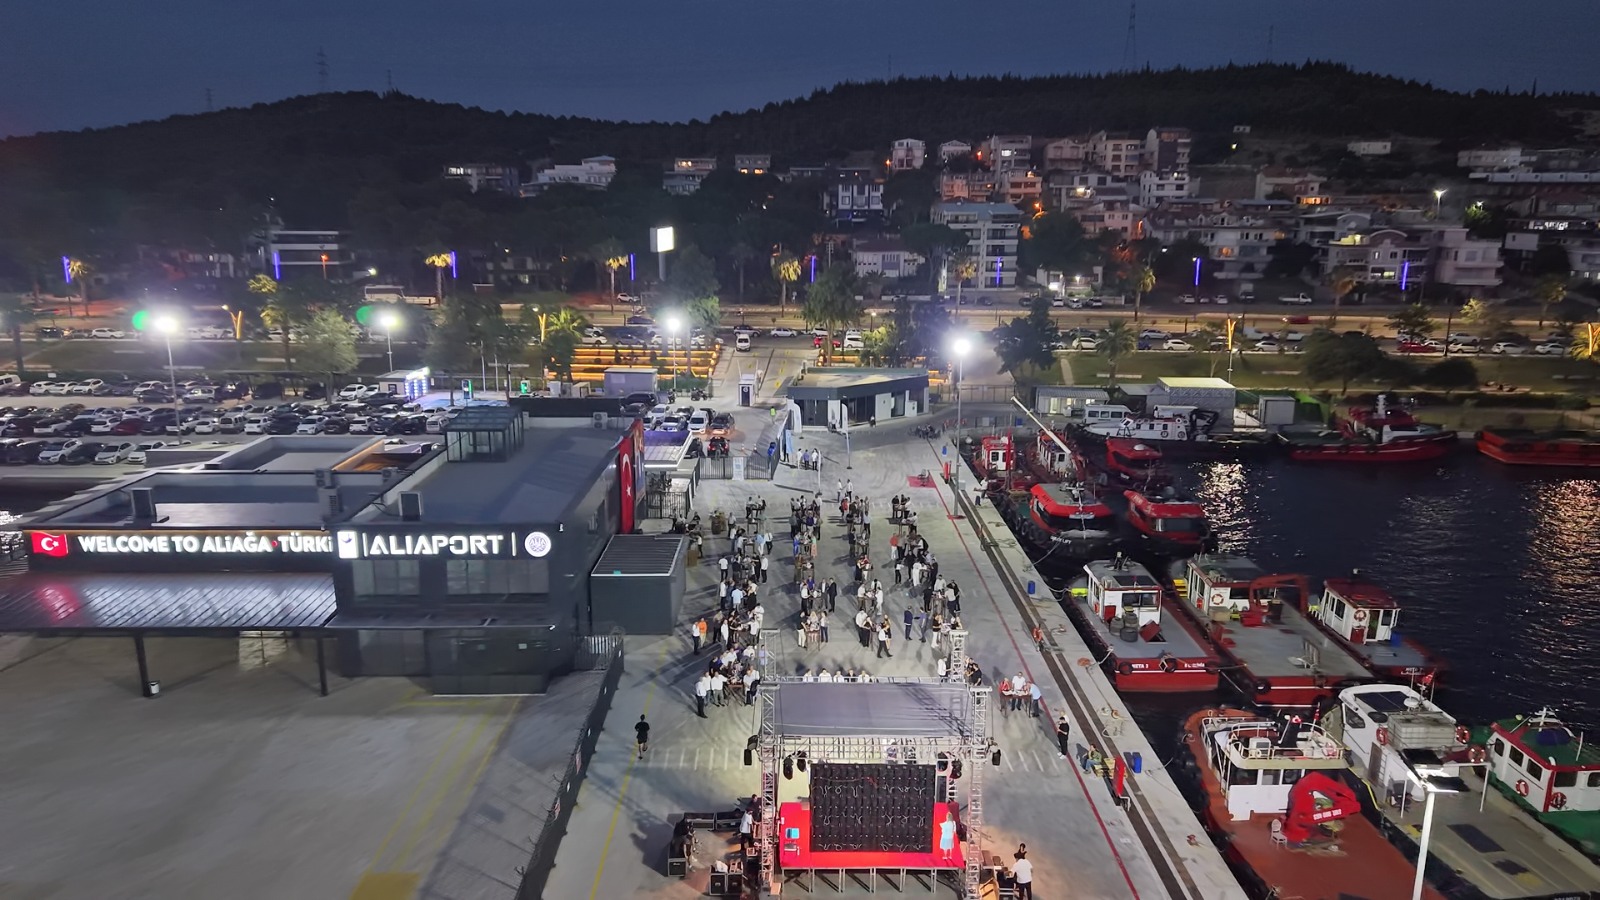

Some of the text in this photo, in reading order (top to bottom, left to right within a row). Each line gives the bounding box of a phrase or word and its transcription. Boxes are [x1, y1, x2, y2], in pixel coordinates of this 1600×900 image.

[78, 535, 169, 552] WELCOME
[171, 535, 200, 552] TO
[369, 534, 504, 555] ALIAPORT
